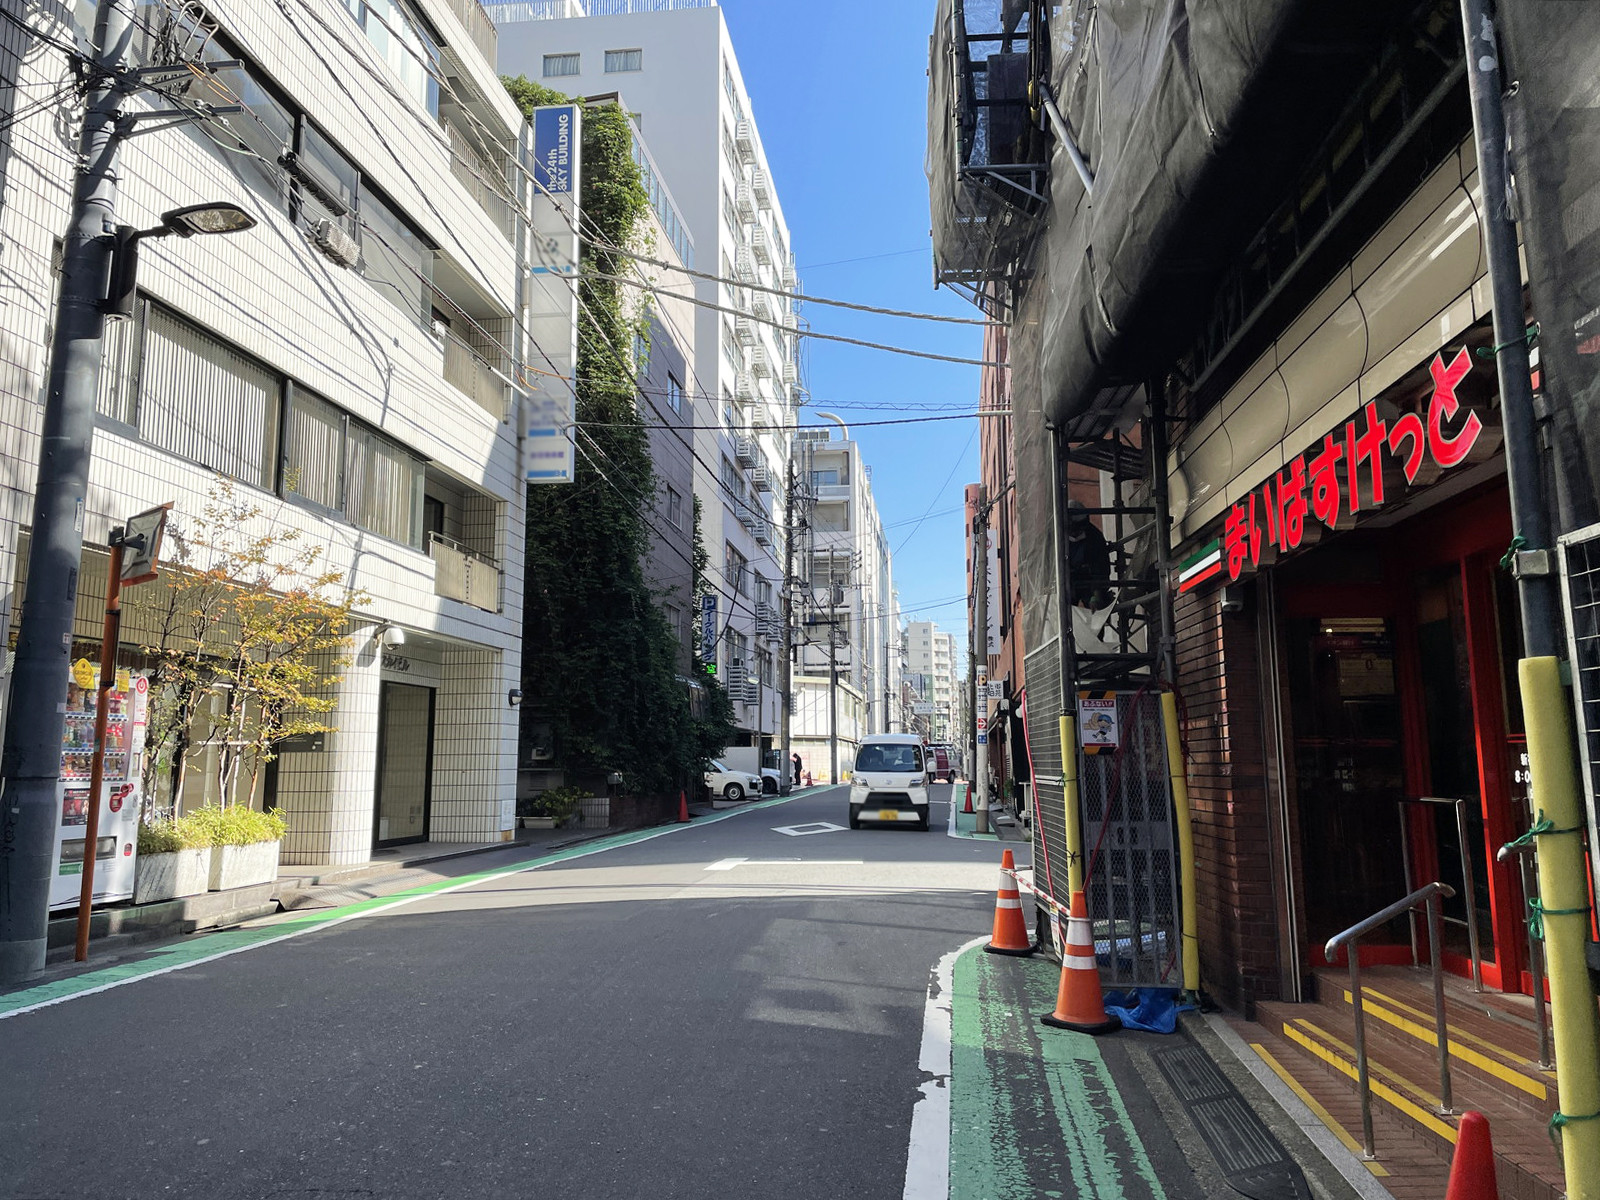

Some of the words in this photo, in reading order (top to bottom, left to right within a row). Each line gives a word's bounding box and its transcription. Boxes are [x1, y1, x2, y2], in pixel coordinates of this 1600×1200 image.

[558, 113, 569, 165] BUILDING
[557, 170, 569, 191] SKY
[1224, 344, 1483, 582] まいばすけっと
